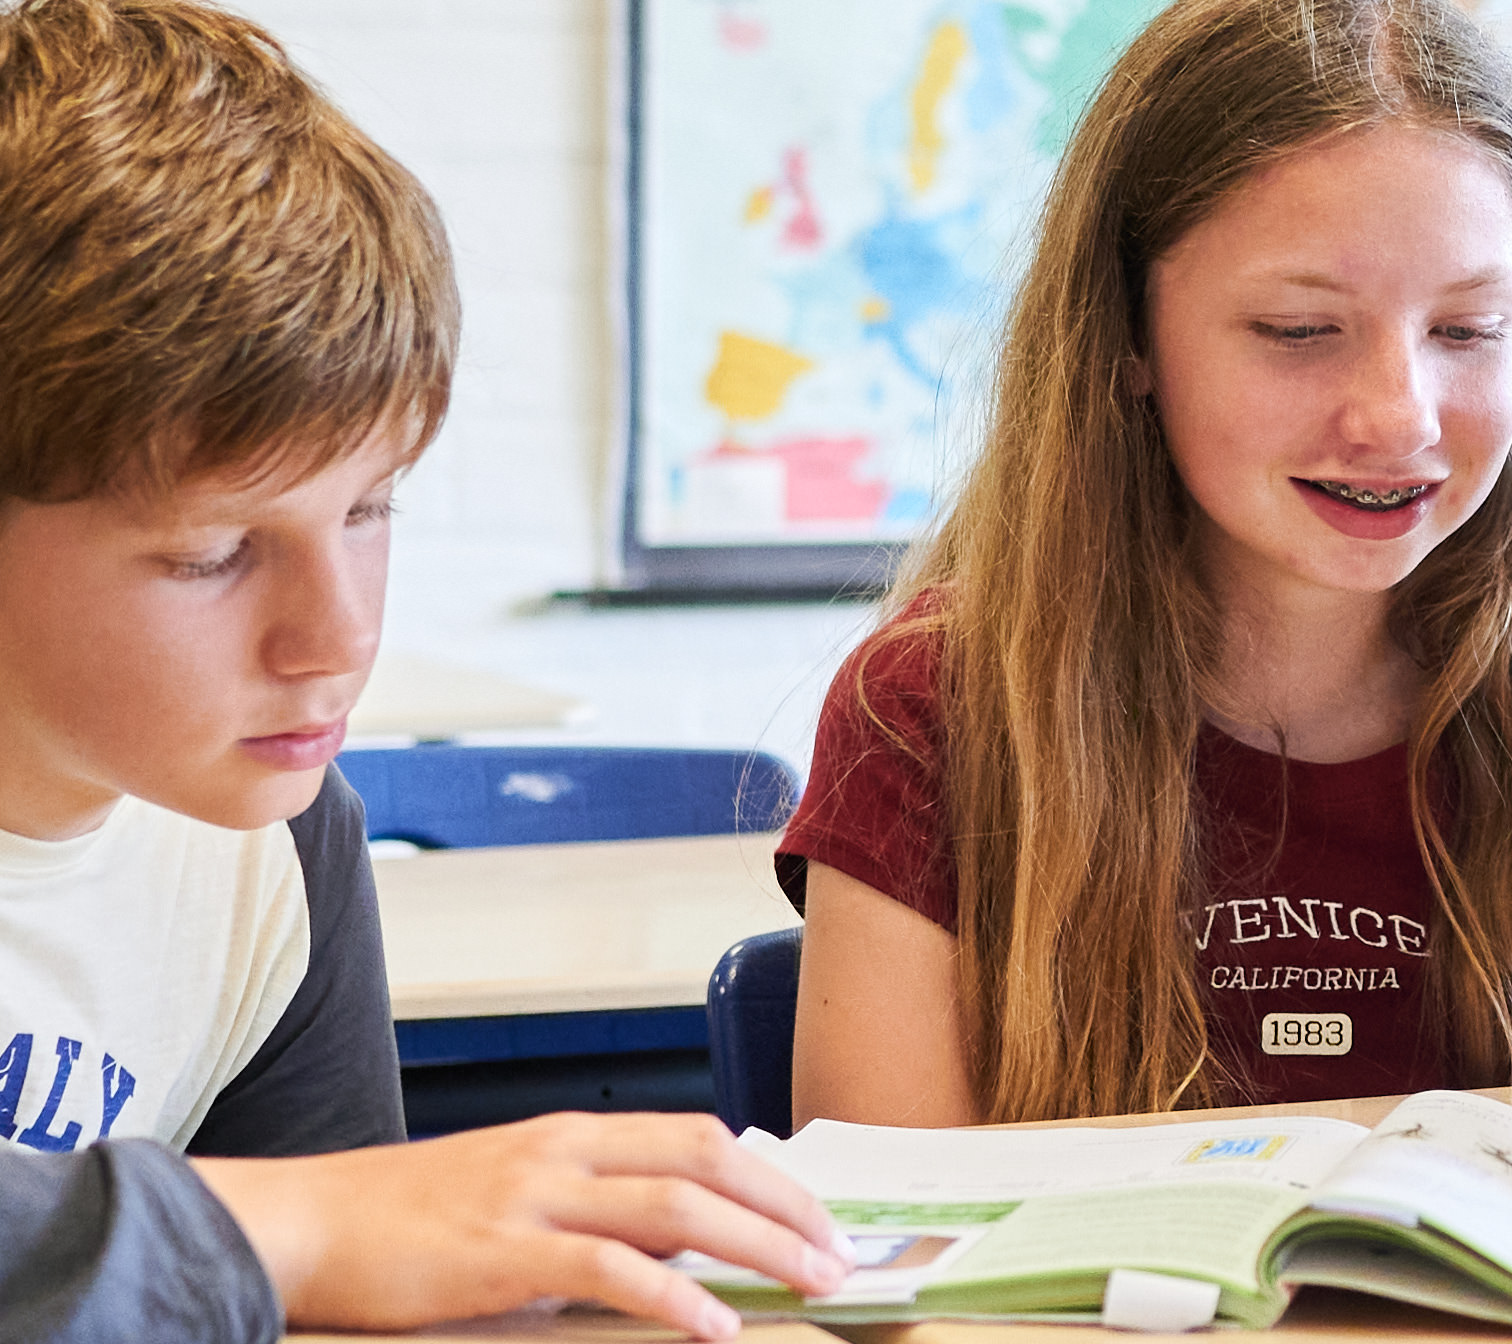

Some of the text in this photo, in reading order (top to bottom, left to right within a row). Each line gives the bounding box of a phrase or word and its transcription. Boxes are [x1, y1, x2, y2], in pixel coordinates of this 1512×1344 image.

[1182, 896, 1432, 957] VENICE
[1210, 966, 1400, 991] CALIFORNIA
[1270, 1020, 1344, 1046] 1983
